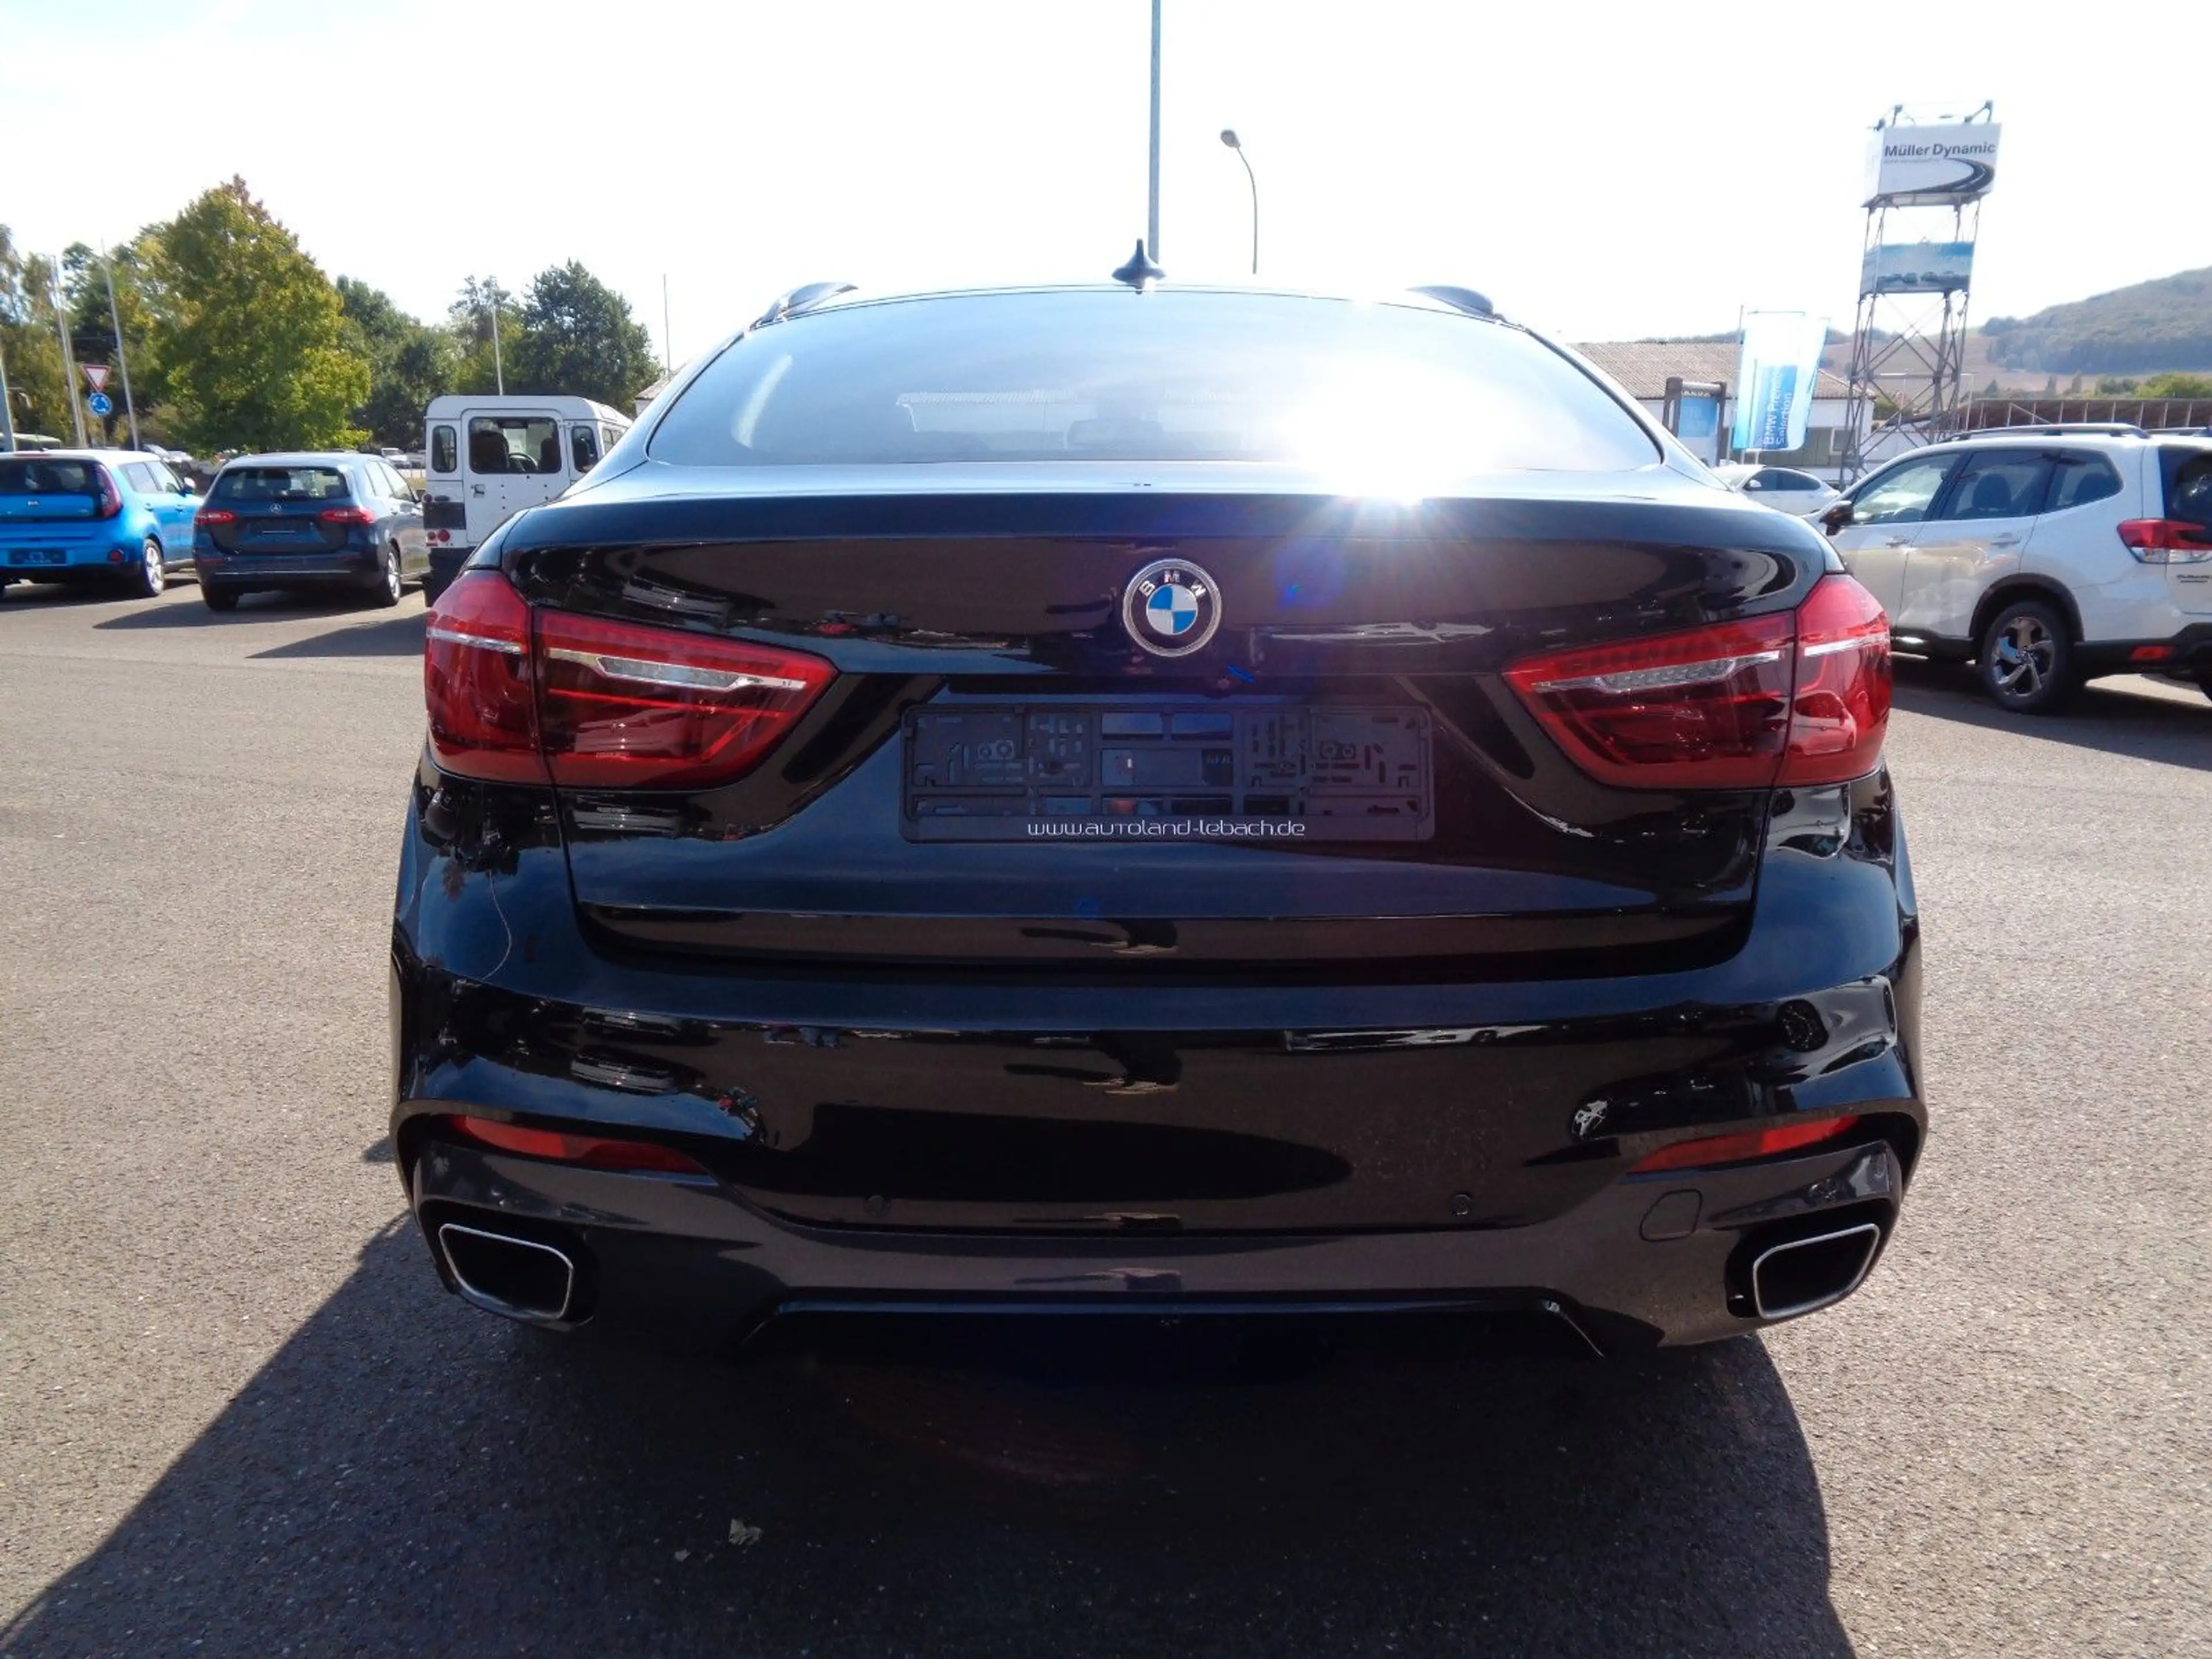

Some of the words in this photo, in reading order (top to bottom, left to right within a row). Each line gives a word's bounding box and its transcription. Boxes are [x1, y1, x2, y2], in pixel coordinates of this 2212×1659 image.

[1884, 145, 1930, 157] Müller
[1933, 142, 1995, 157] Dynamic
[1776, 392, 1792, 445] Selection
[1138, 570, 1206, 597] BMW
[1028, 819, 1305, 836] www.autoland-lebach.de
